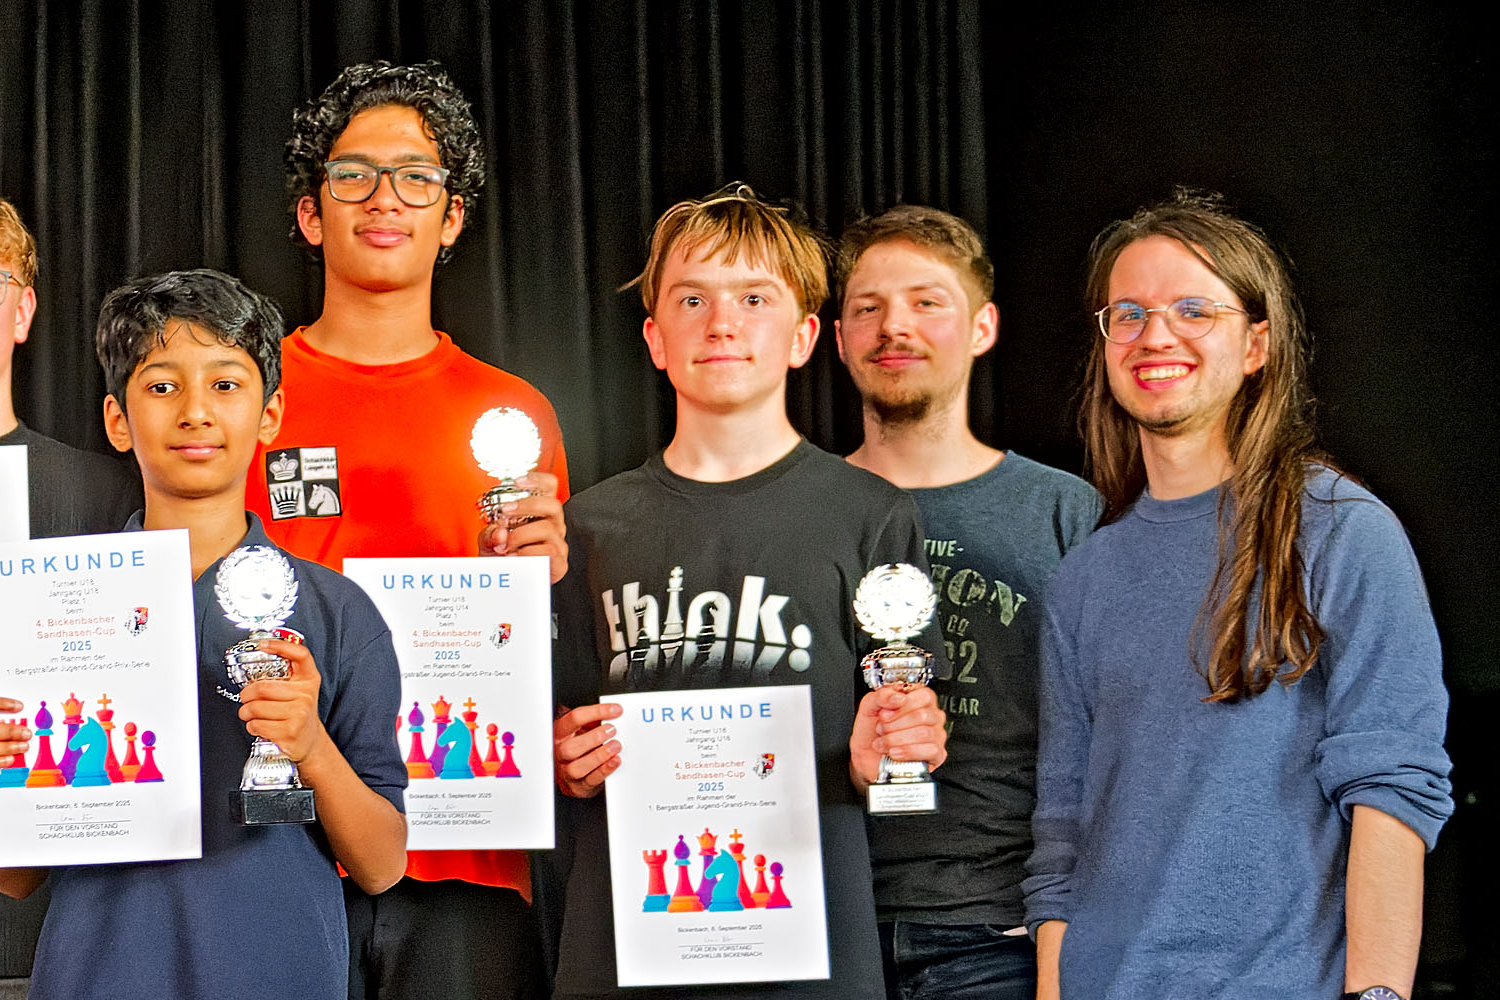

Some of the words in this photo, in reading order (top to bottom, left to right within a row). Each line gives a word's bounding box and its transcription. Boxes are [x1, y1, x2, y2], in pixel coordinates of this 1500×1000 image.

[924, 539, 964, 557] TIVE-
[0, 549, 146, 576] URKUNDE
[383, 572, 510, 590] URKUNDE
[35, 619, 44, 628] 4.
[47, 613, 115, 627] Bickenbacher
[35, 626, 116, 641] Sandhasen-Cup
[422, 628, 482, 637] Bickenbacher
[61, 639, 92, 652] 2025
[412, 639, 482, 649] Sandhasen-Cup
[434, 650, 461, 660] 2025
[642, 702, 771, 723] URKUNDE
[674, 762, 682, 770] 4.
[684, 758, 745, 769] Bickenbacher
[674, 769, 745, 781] Sandhasen-Cup
[697, 781, 725, 792] 2025
